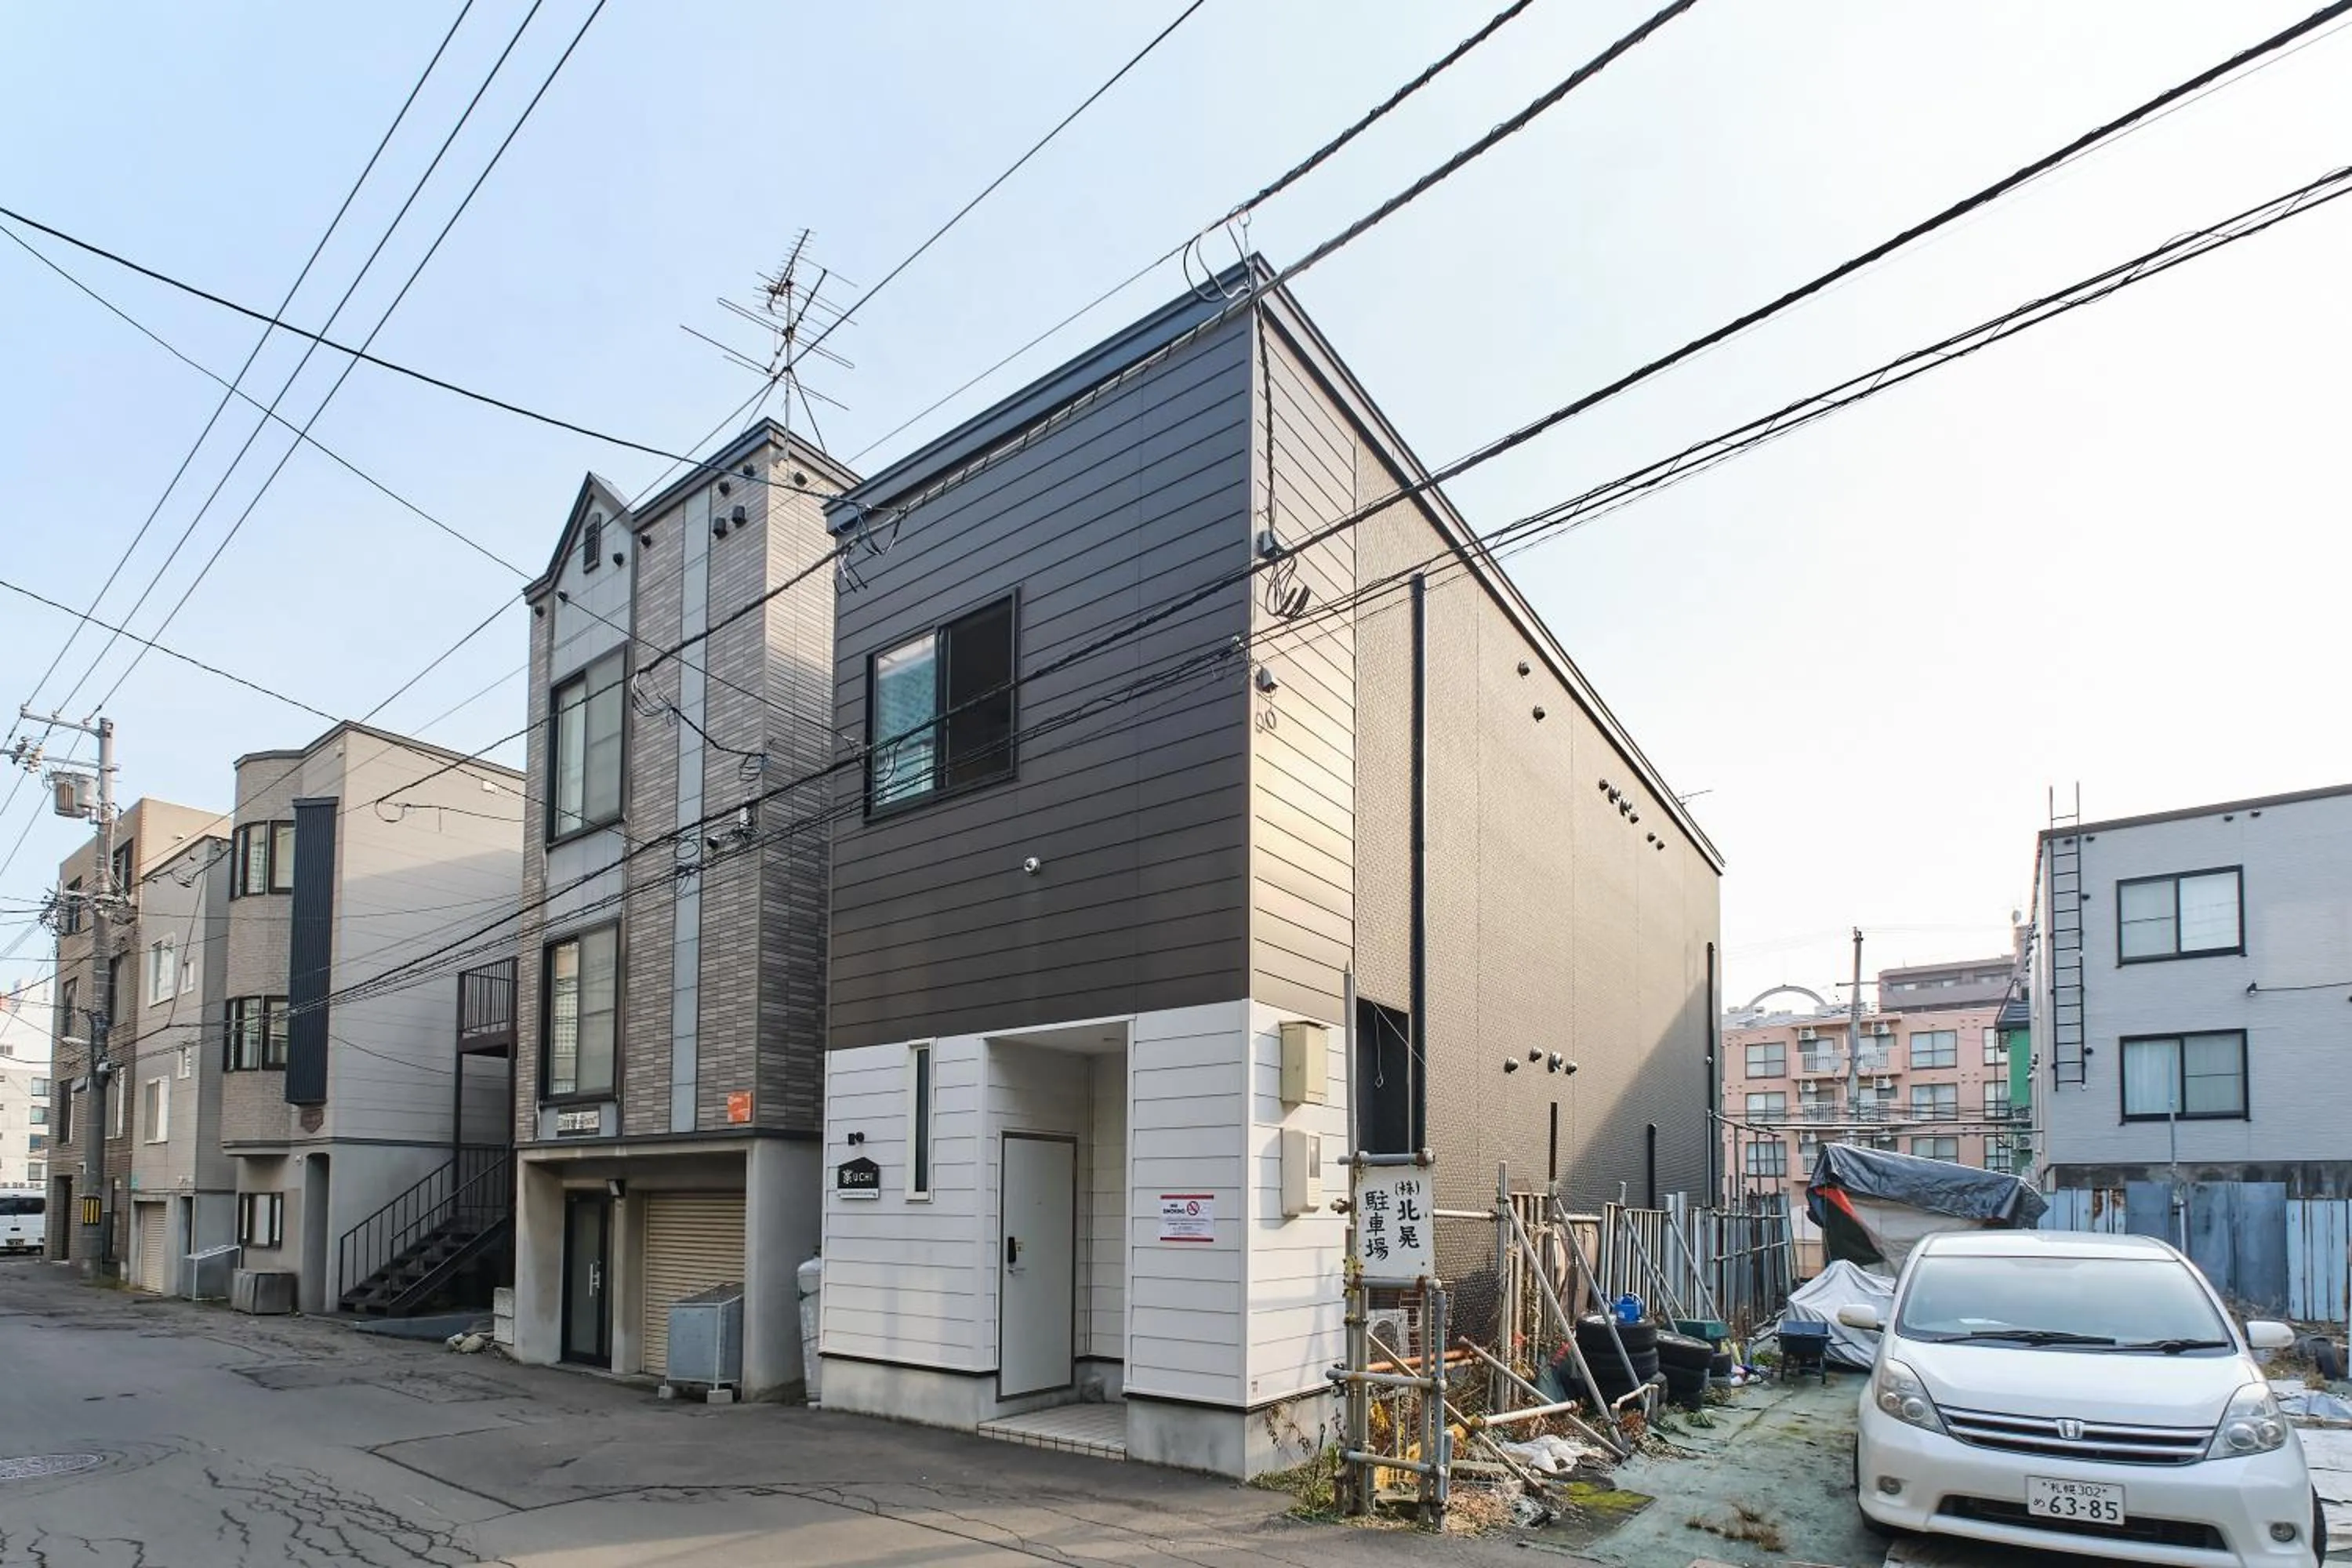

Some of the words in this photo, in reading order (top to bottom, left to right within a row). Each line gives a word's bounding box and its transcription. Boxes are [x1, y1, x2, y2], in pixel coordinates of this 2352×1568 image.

[1365, 1189, 1389, 1261] 駐車場
[2049, 1496, 2118, 1520] 63-85
